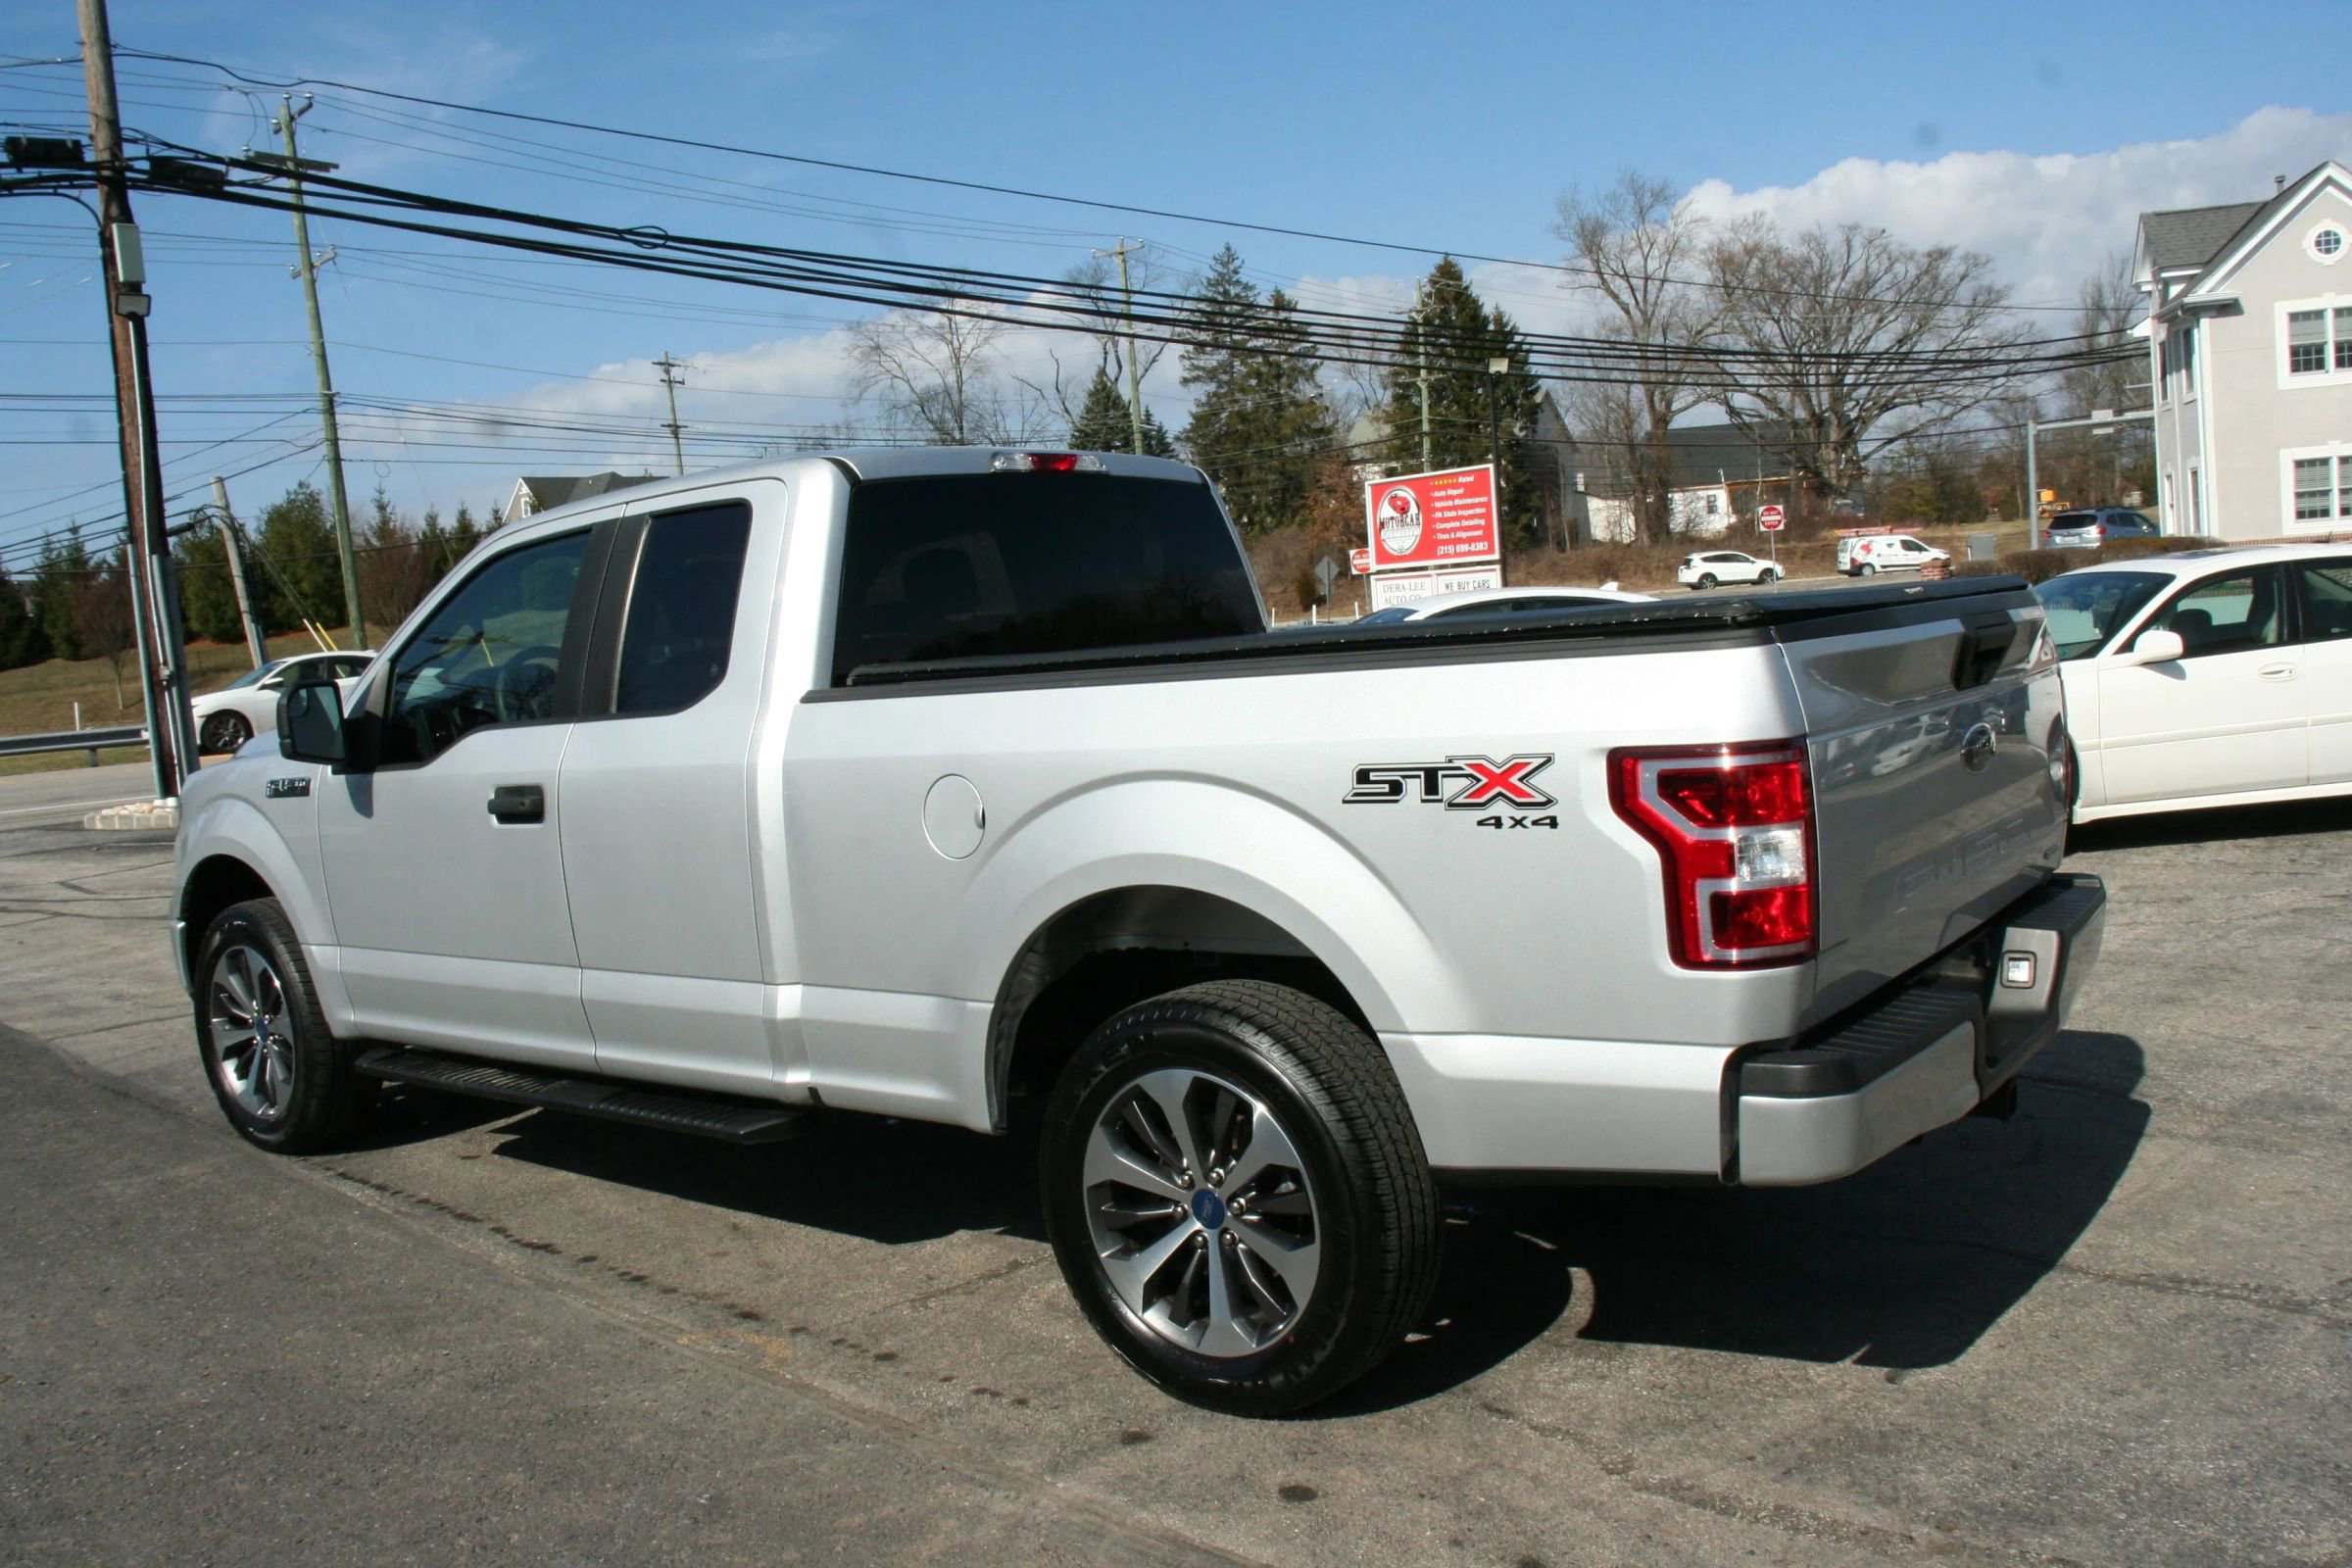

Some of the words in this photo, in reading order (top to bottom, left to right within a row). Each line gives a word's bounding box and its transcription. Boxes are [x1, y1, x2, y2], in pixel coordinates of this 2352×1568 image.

[1446, 487, 1464, 496] Repair
[1453, 496, 1488, 506] Maintenance
[1457, 508, 1486, 516] Inspection
[1461, 518, 1486, 527] Detailing
[1455, 529, 1483, 539] Alignment
[1437, 544, 1454, 557] (215)
[1445, 581, 1454, 592] WE
[1457, 580, 1470, 591] BUY
[1473, 579, 1491, 591] CARS
[1342, 753, 1558, 810] STX
